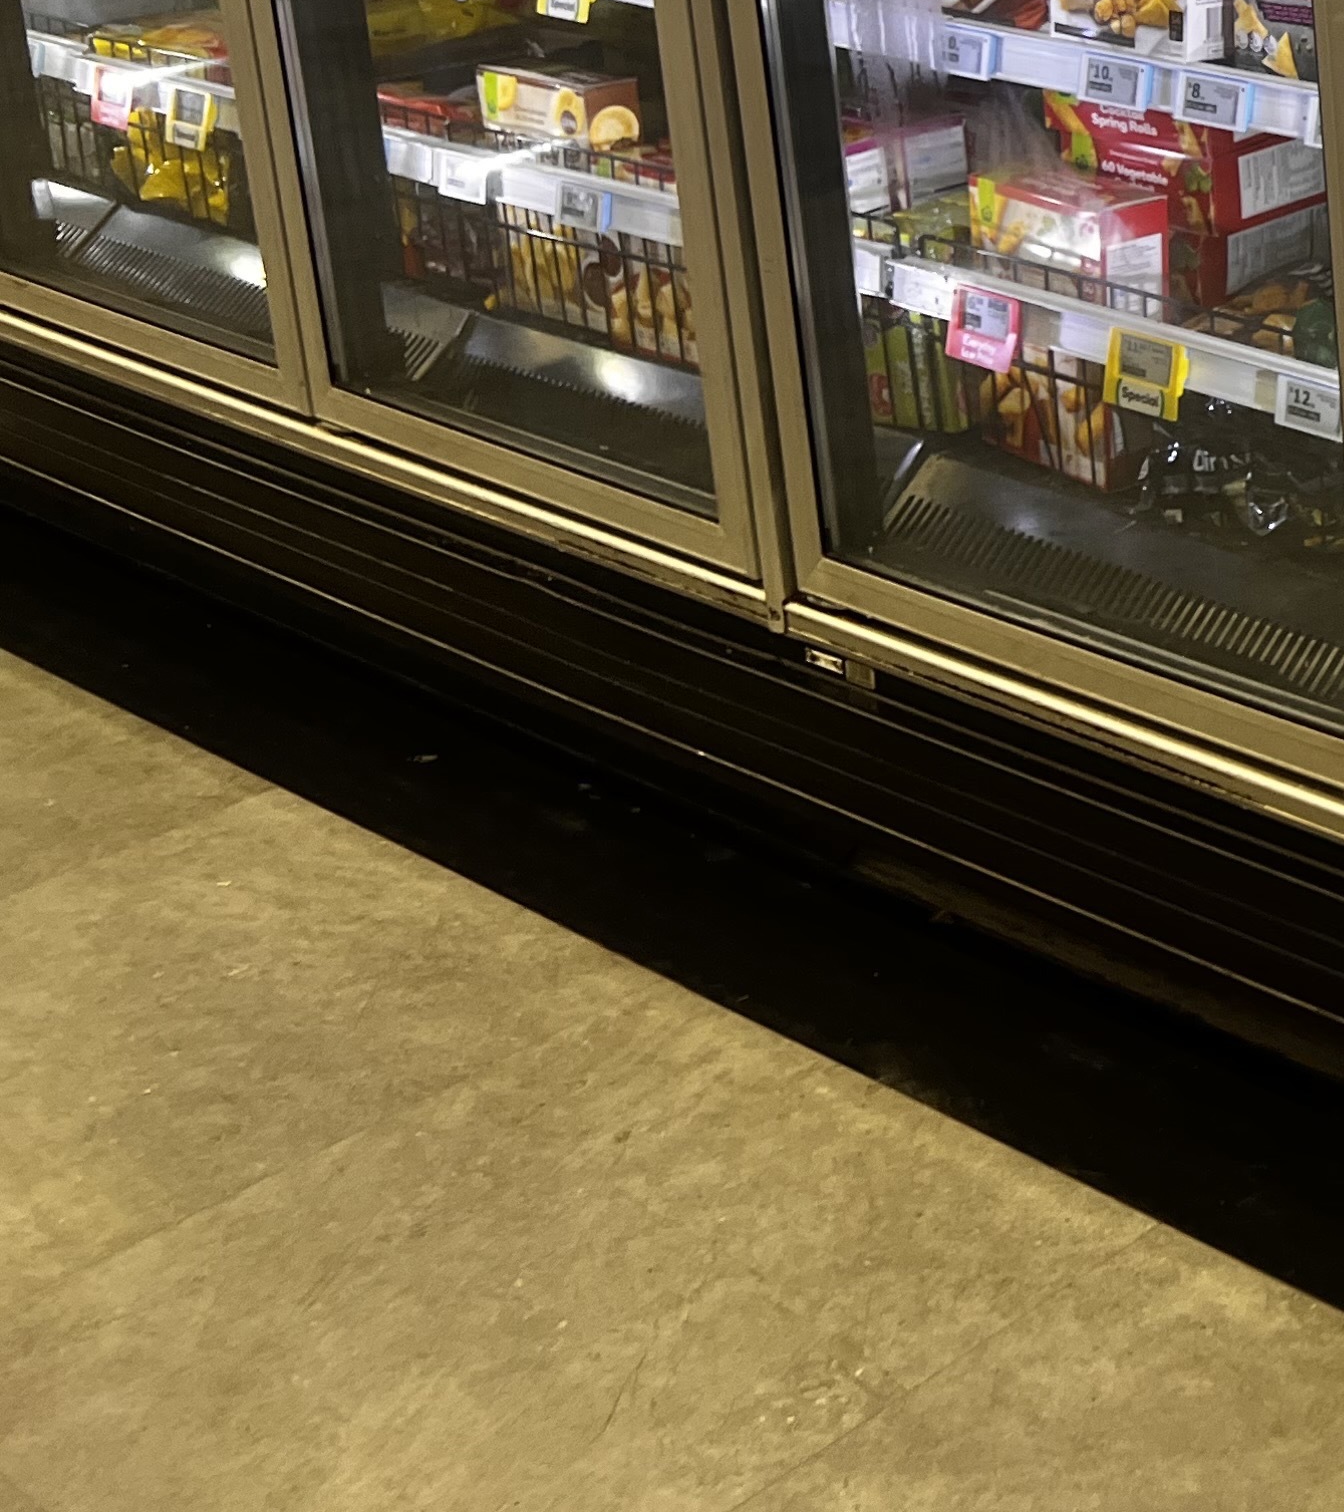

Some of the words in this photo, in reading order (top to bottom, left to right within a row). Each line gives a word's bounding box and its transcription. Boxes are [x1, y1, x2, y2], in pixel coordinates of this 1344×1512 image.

[1091, 111, 1127, 130] Spring
[1128, 119, 1158, 136] Rolls
[1121, 388, 1160, 408] Special
